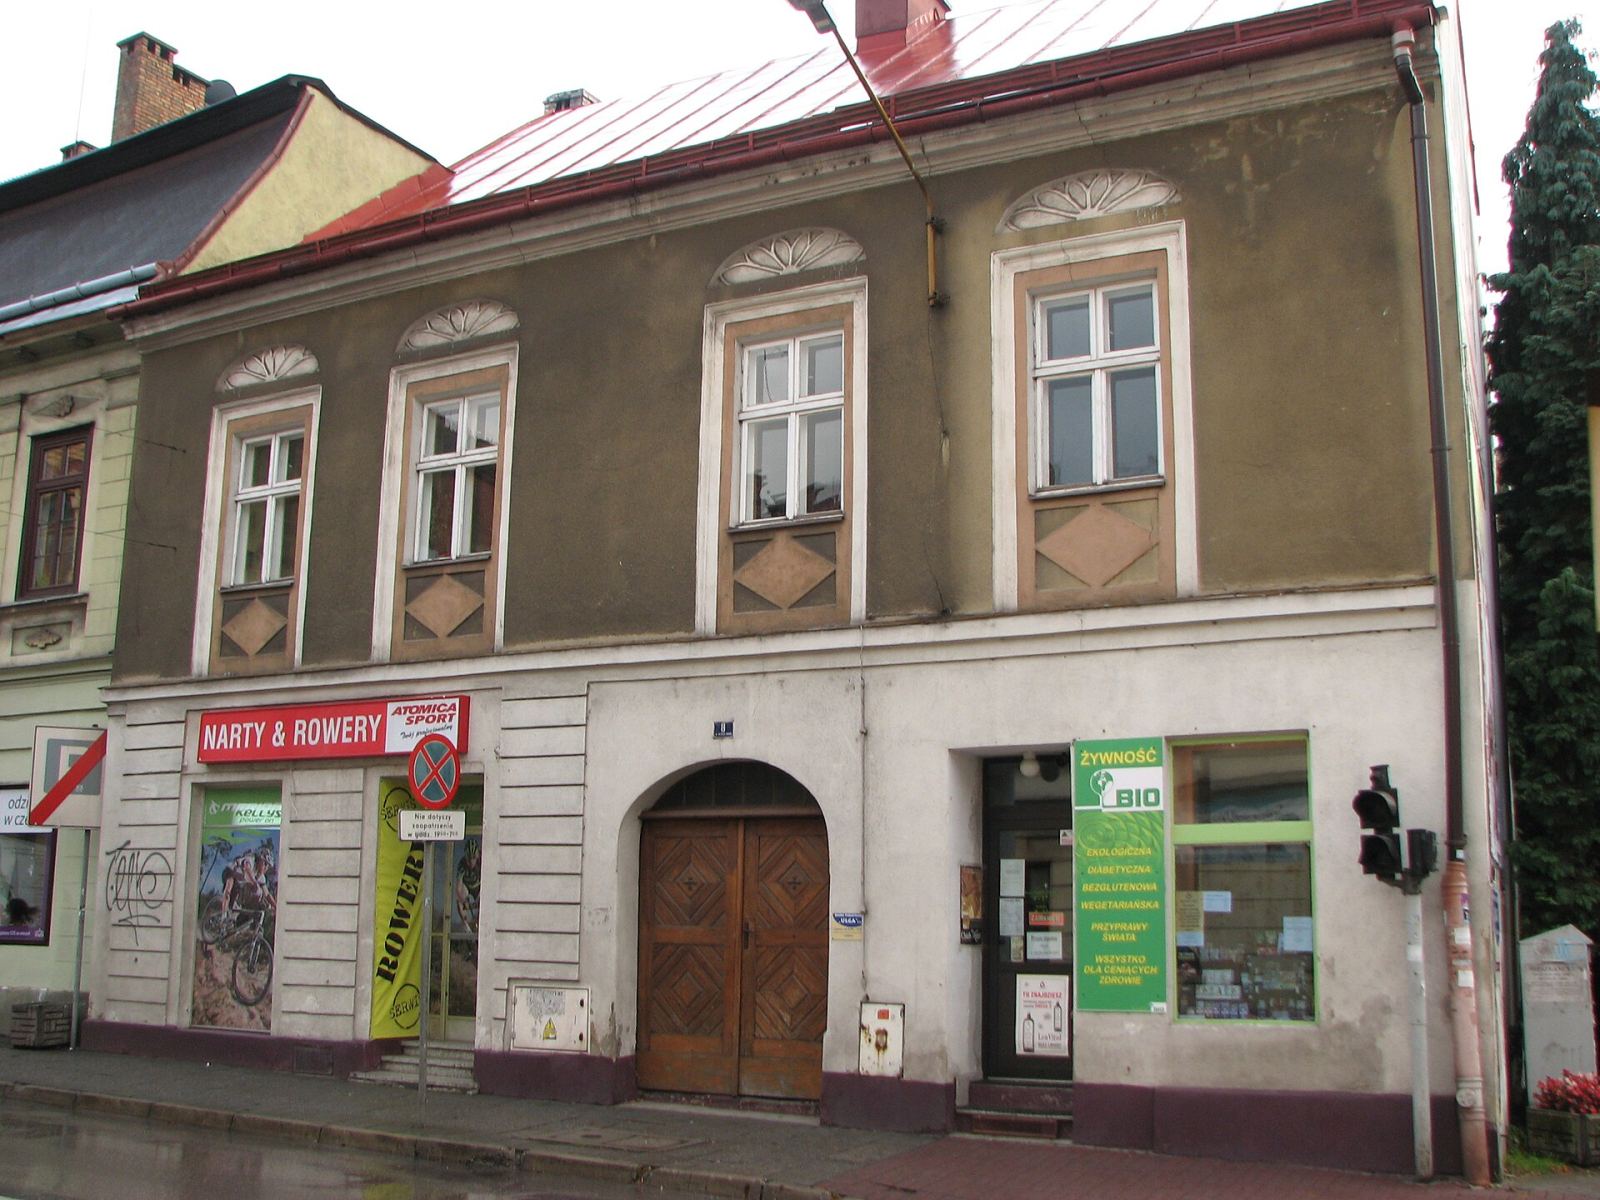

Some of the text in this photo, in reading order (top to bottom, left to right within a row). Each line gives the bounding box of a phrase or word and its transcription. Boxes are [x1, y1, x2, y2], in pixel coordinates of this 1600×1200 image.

[391, 702, 457, 716] ATOMICA
[404, 712, 457, 726] SPORT
[203, 714, 382, 750] NARTY & ROWERY
[1080, 746, 1157, 766] ŻYWNOŚĆ
[1116, 788, 1160, 807] BIO
[428, 814, 451, 822] dotyczy
[1086, 847, 1152, 856] EKOLOGICZNA
[1087, 865, 1152, 874] DIABETYCZNA
[1082, 882, 1158, 892] BEZGLUTENOWA
[1081, 899, 1159, 910] WEGETARIAŃSKA
[376, 841, 424, 985] ROWER
[1091, 922, 1149, 931] PRZYPRAWY
[1102, 931, 1137, 941] ŚWIATA
[1095, 954, 1146, 963] WSZYSTKO
[1083, 965, 1159, 975] DLA CENIĄCYCH
[1099, 975, 1143, 985] ZDROWIE
[390, 992, 420, 1019] SERWI
